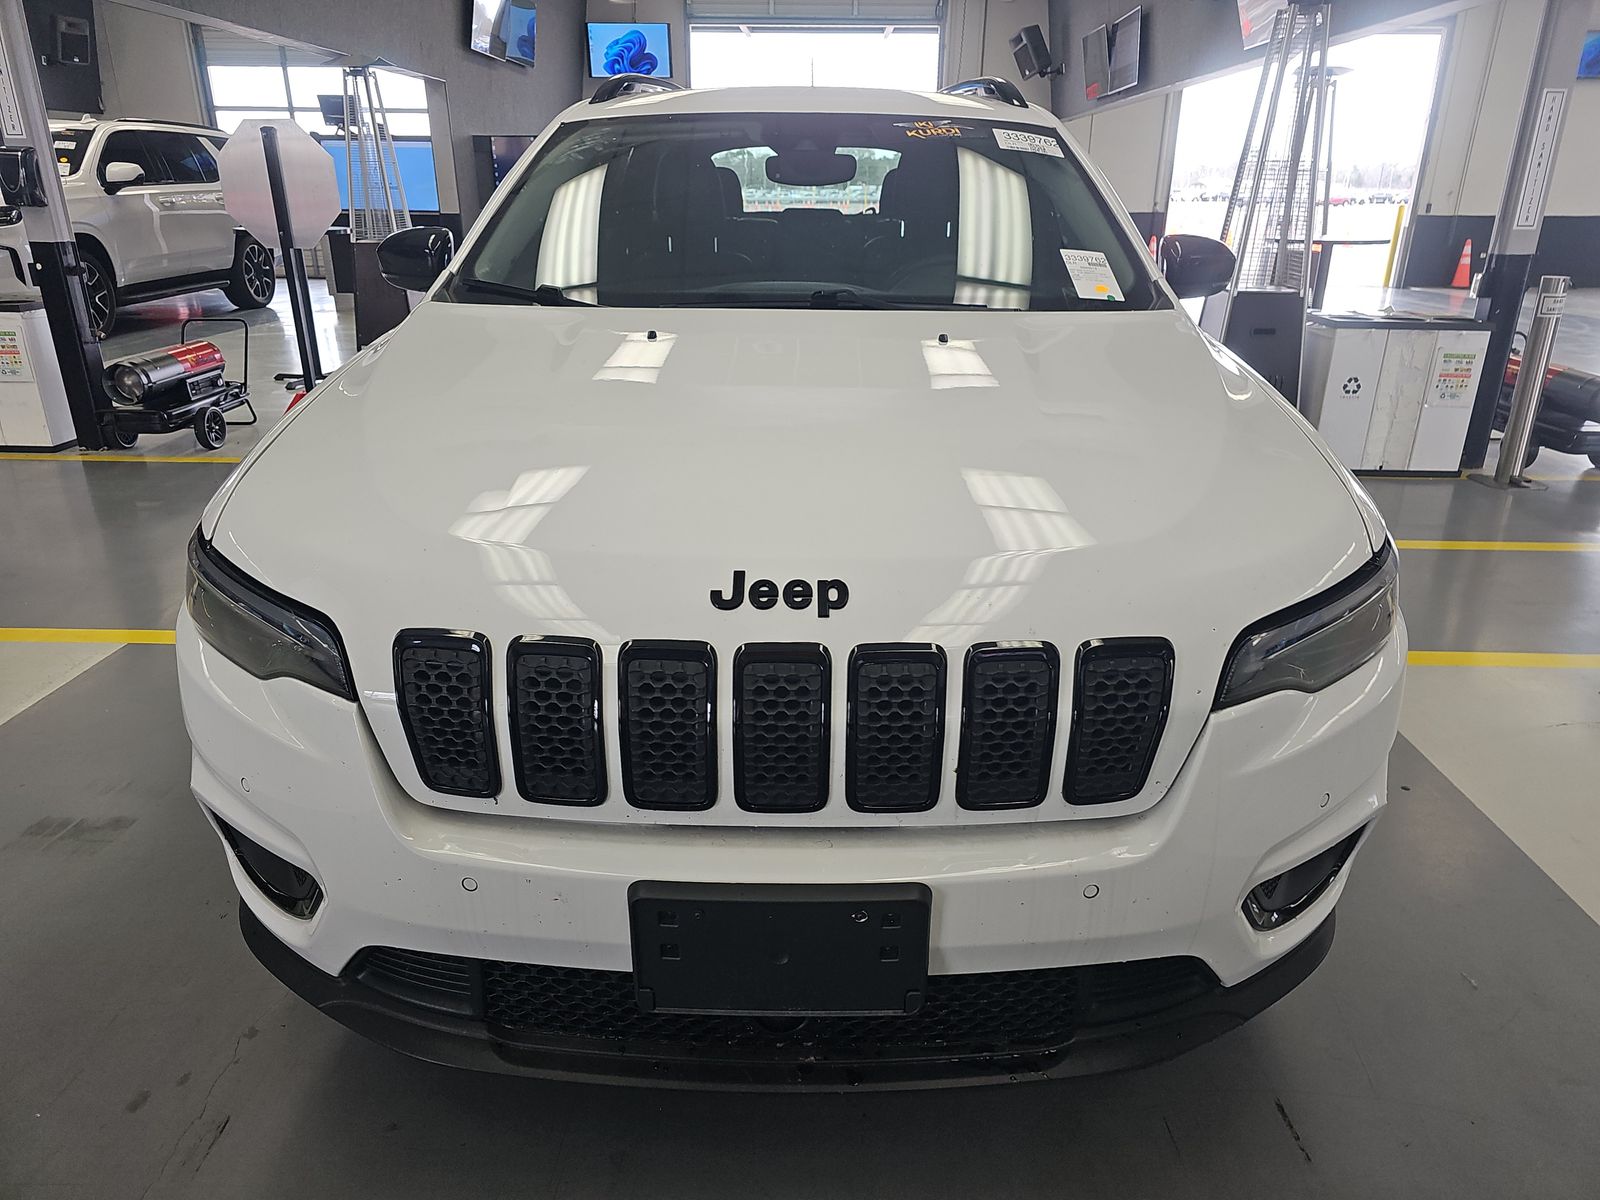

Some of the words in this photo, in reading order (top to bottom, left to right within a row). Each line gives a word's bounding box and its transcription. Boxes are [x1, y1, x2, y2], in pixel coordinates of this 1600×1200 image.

[1546, 95, 1558, 132] HAND
[1525, 142, 1546, 222] SANITIZER
[709, 570, 850, 618] Jeep
